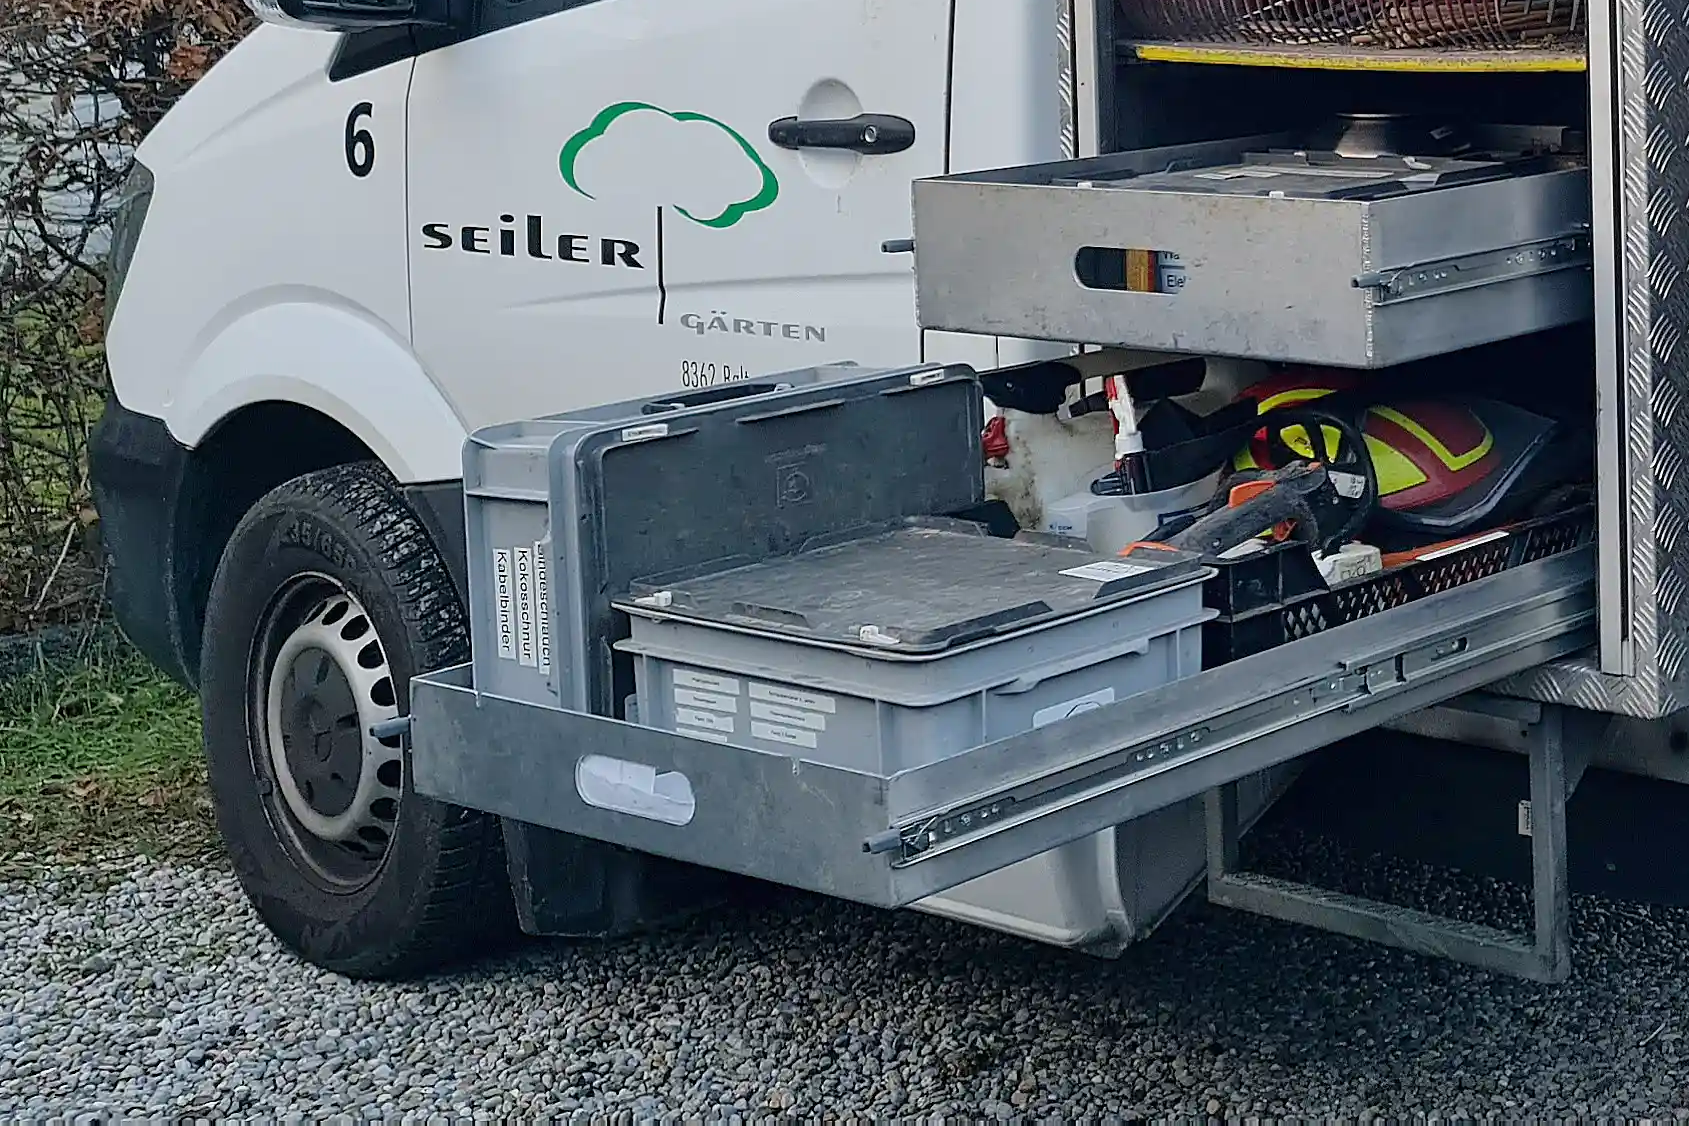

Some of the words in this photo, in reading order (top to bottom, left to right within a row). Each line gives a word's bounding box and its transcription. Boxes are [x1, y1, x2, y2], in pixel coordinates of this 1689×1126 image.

[344, 101, 375, 177] 6
[680, 310, 827, 343] GÄRTEN
[682, 360, 716, 387] 8362
[497, 551, 511, 652] Kabelbinder
[518, 550, 532, 660] Kokosschnur
